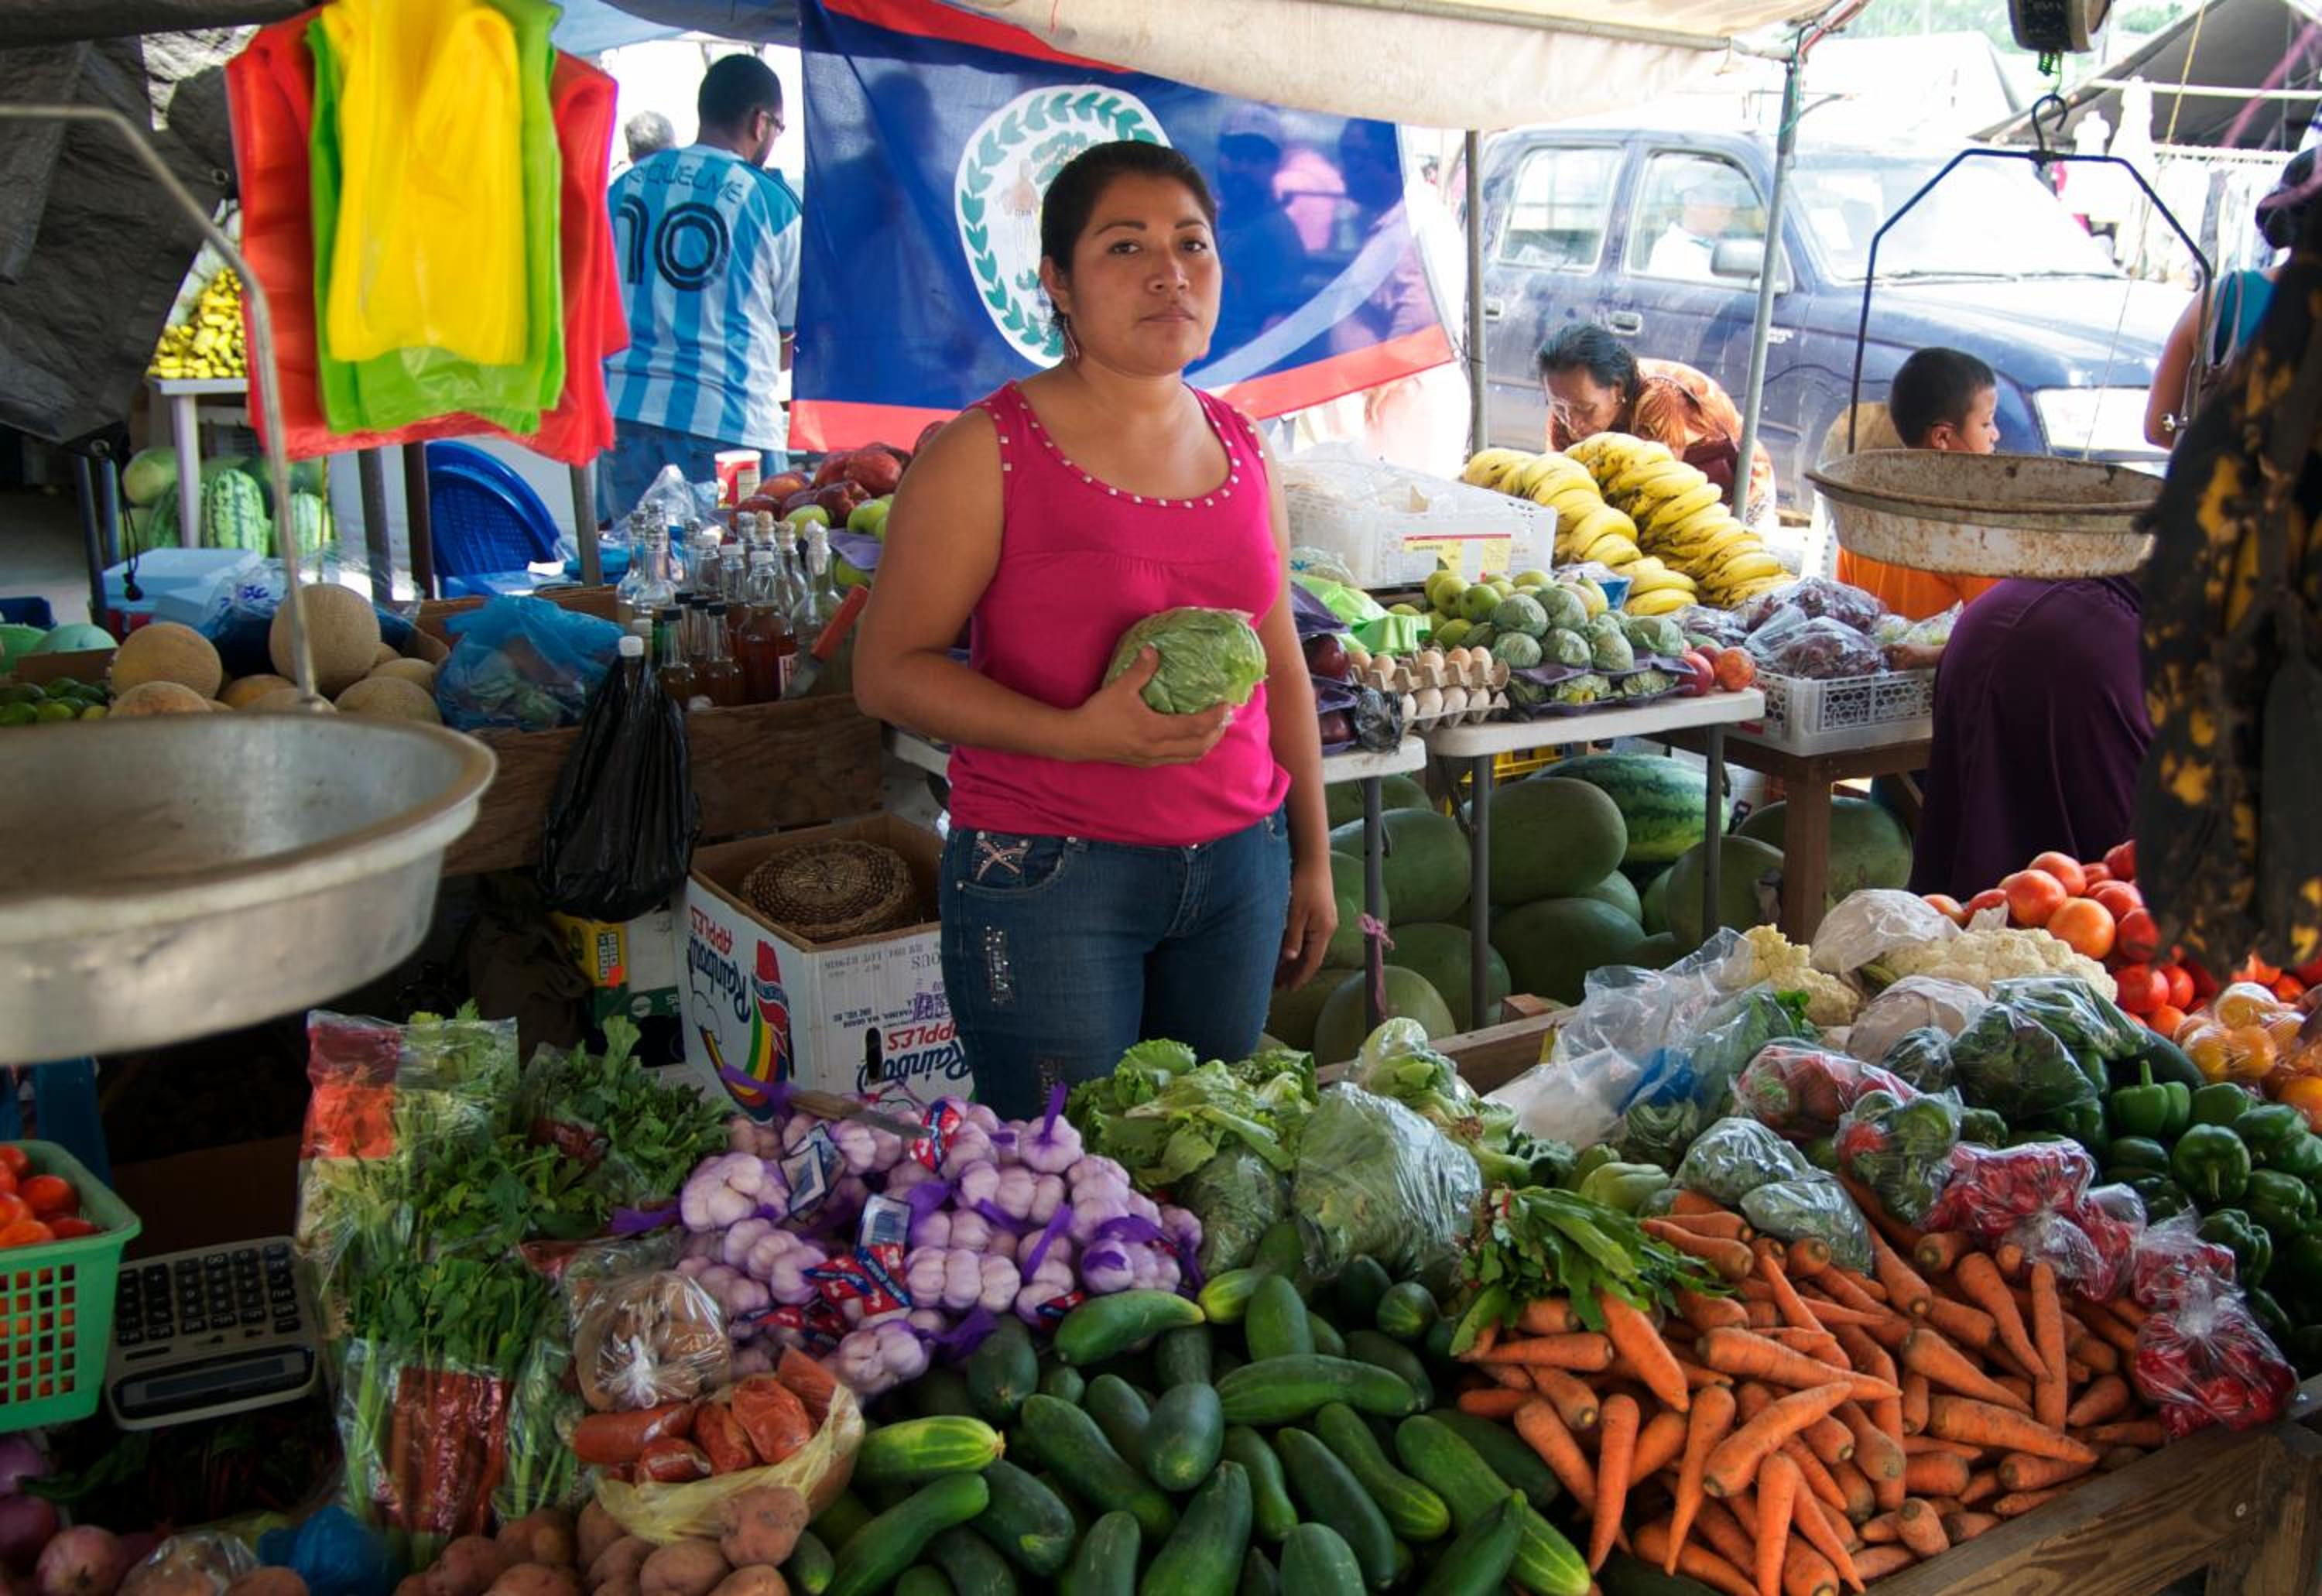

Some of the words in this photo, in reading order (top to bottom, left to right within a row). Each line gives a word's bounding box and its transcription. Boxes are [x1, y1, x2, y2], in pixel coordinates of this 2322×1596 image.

[615, 193, 731, 293] 10
[690, 905, 733, 956] APPLES
[687, 937, 752, 1024] Rainbow
[887, 1020, 957, 1051] PPLES
